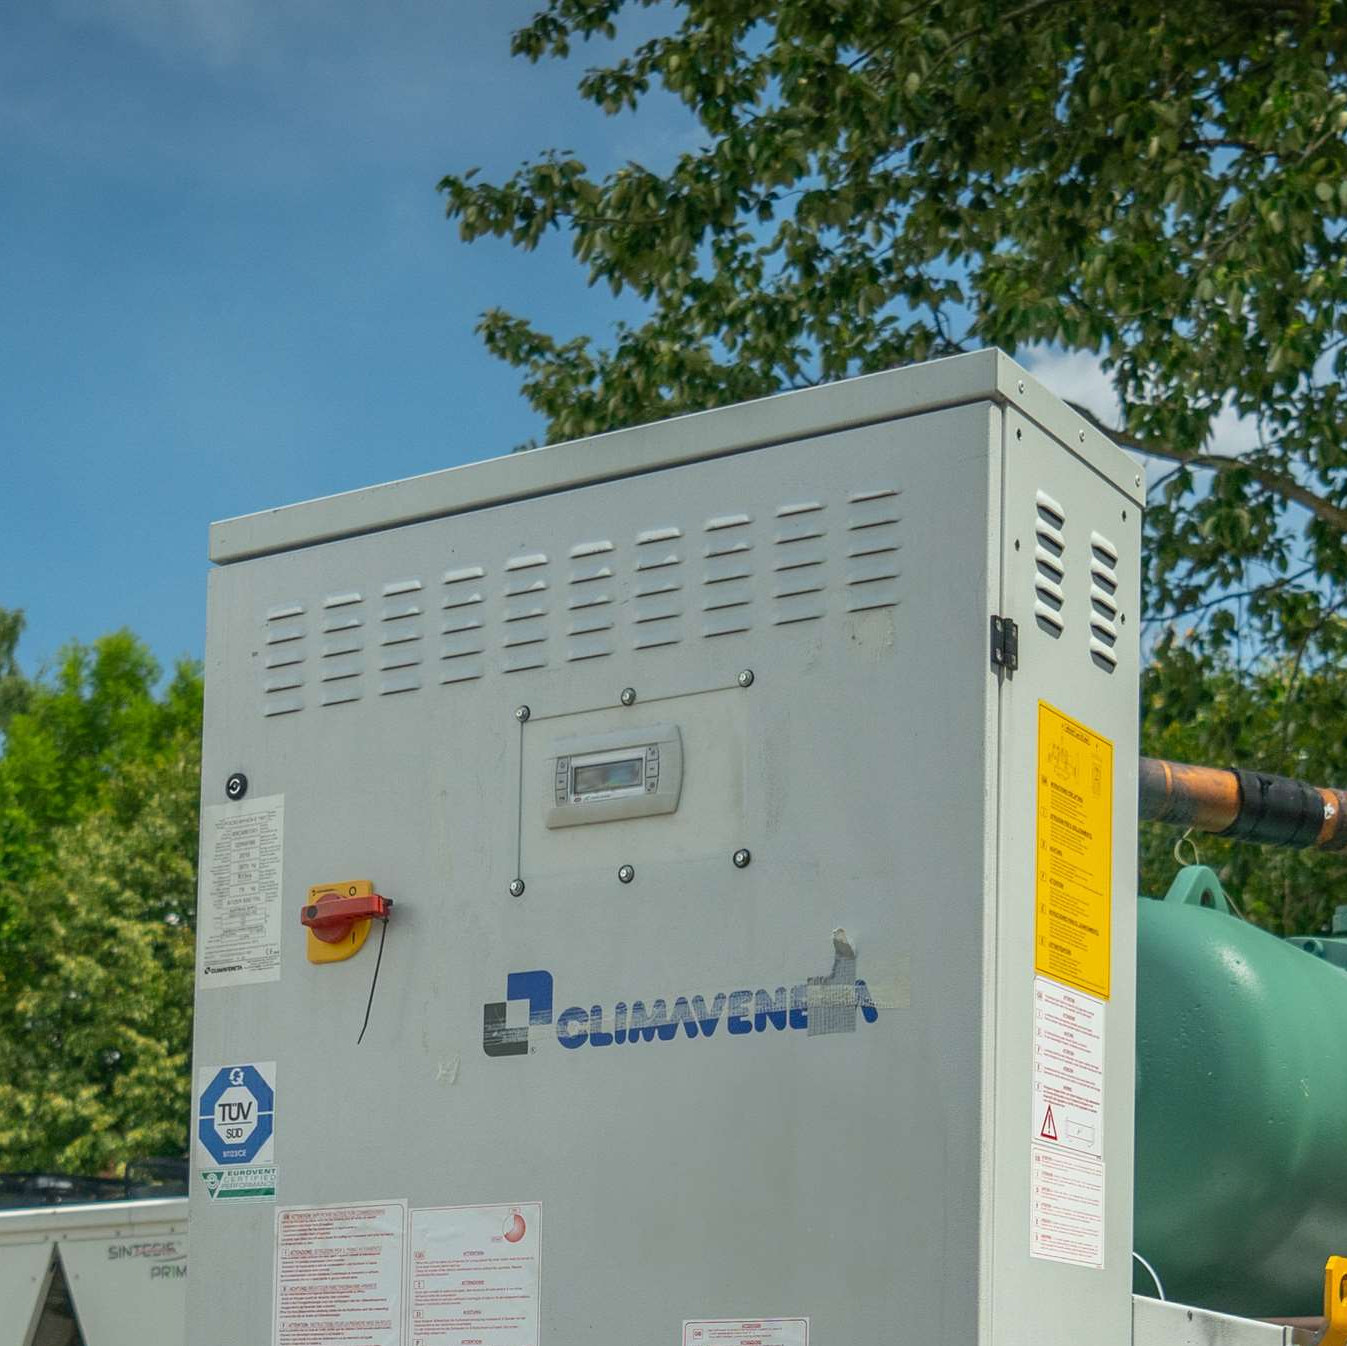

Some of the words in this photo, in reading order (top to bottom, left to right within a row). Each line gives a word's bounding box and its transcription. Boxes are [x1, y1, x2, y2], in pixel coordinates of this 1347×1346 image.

[557, 979, 879, 1050] CLIMAVENEA
[218, 1101, 253, 1121] TÜV
[225, 1127, 243, 1139] SÜD
[227, 1168, 276, 1177] EUROVENT
[224, 1175, 277, 1183] CERTIFIED
